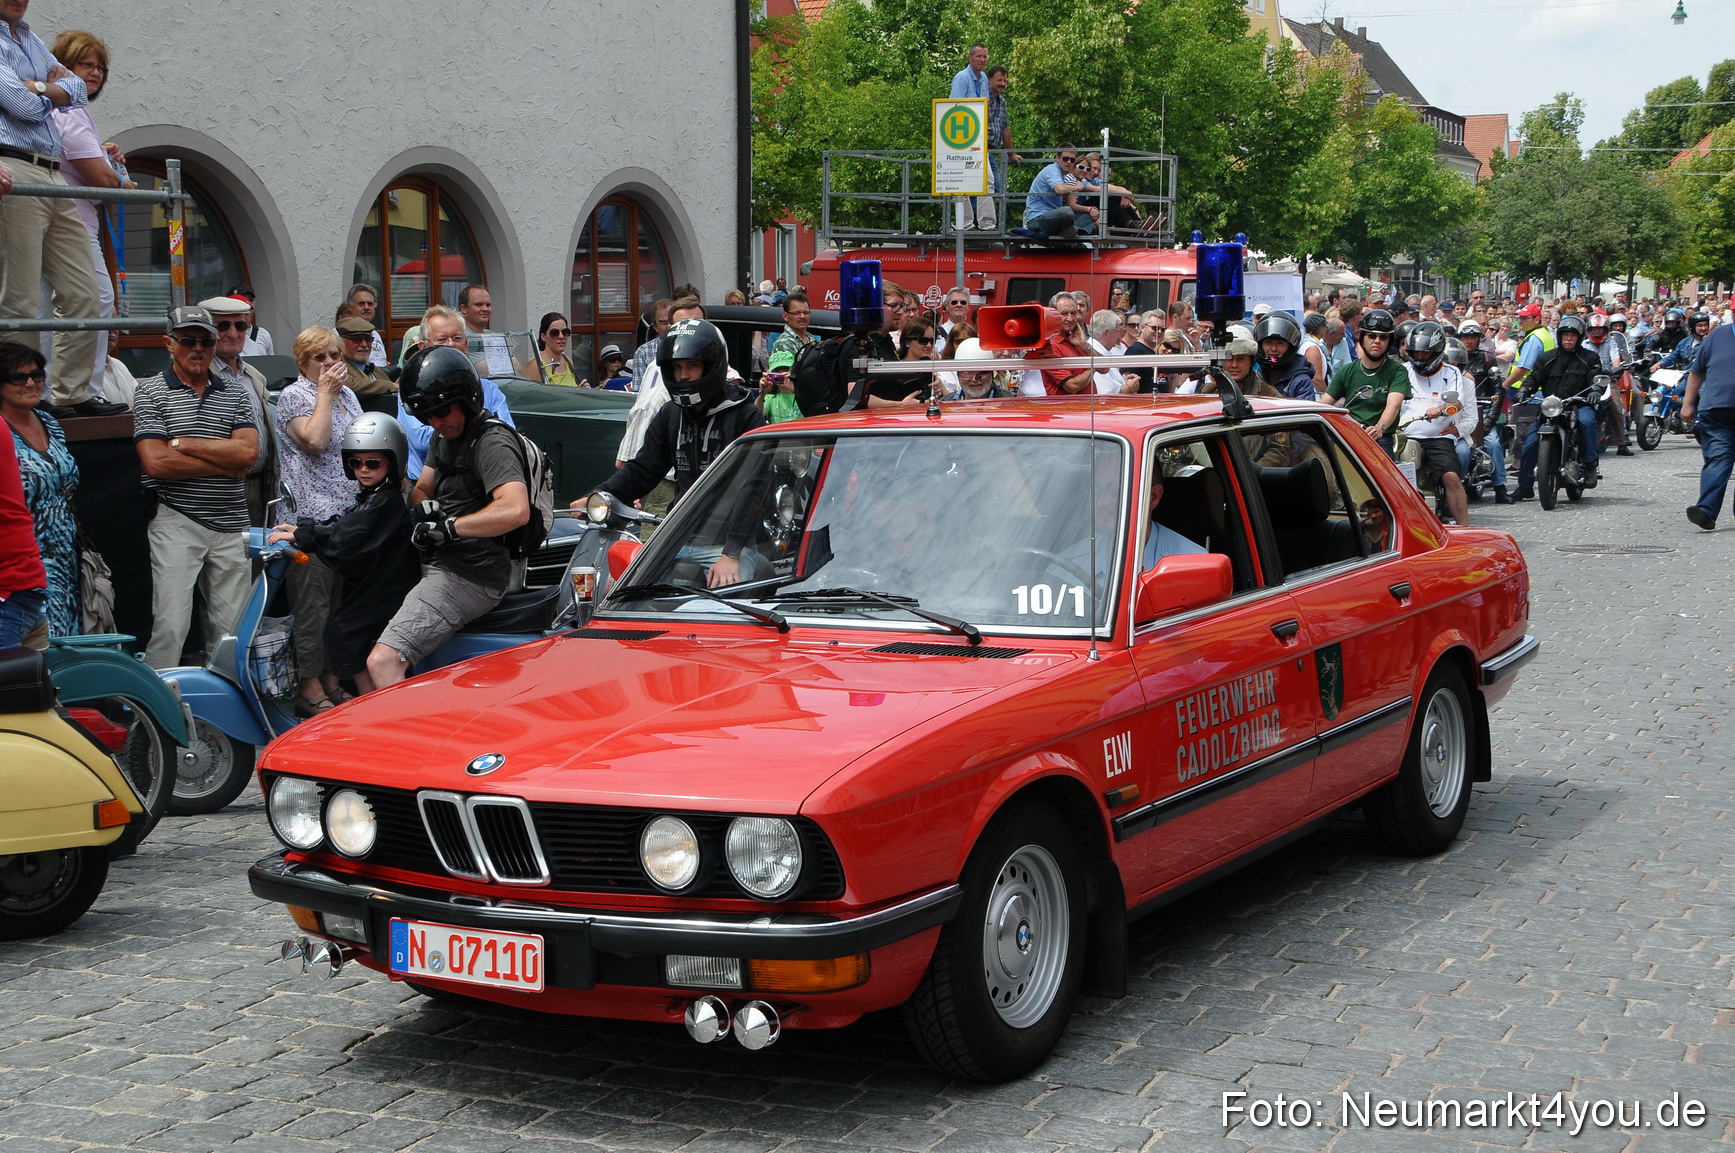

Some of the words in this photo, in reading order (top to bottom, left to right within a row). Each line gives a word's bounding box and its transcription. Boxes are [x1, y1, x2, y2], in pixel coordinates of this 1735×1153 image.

[951, 116, 969, 139] H
[824, 289, 840, 301] Ko
[1012, 584, 1085, 618] 10/1
[1175, 669, 1277, 739] FEUERWEHR
[1102, 730, 1132, 779] ELW
[1176, 708, 1281, 783] CADOLZBURG
[396, 952, 404, 963] D
[409, 928, 426, 969] N
[449, 934, 539, 984] 07110
